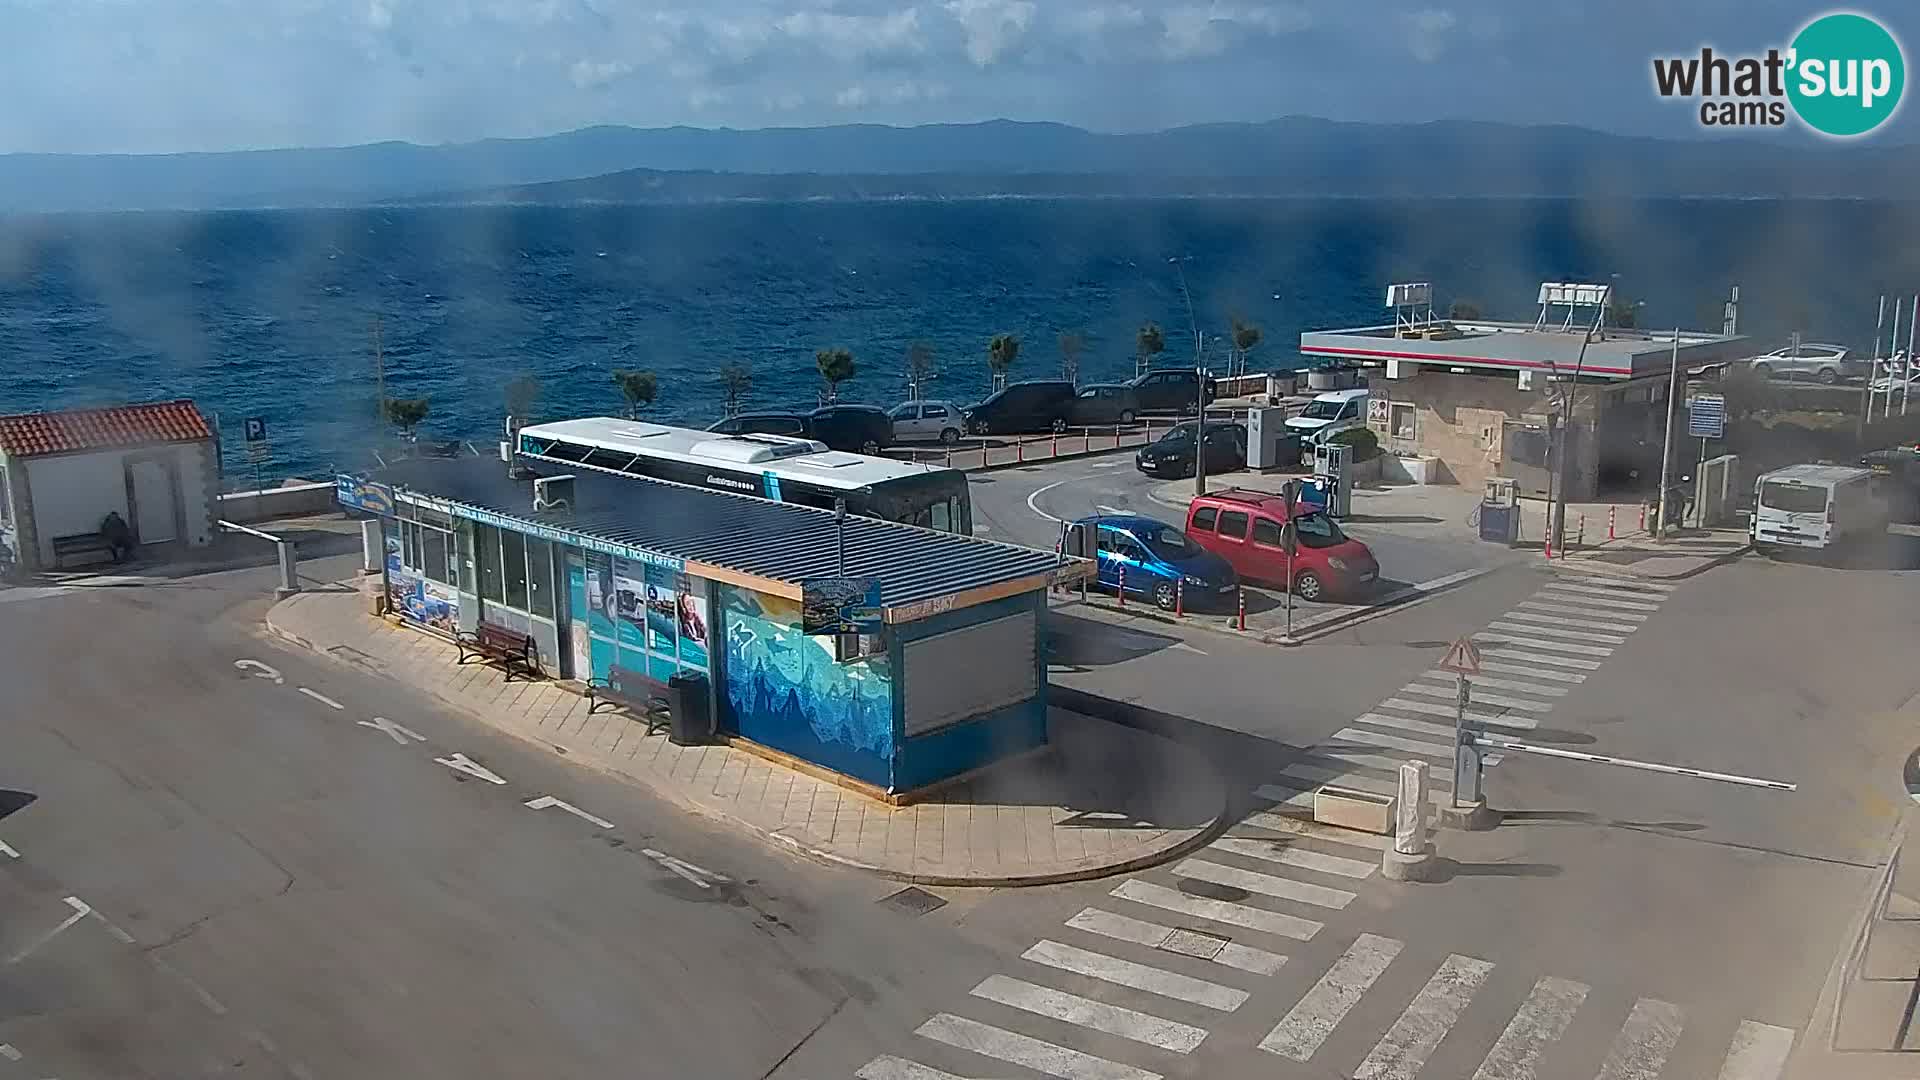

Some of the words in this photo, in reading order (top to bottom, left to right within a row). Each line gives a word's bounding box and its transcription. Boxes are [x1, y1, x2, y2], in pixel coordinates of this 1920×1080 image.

[248, 420, 261, 438] P
[579, 537, 594, 550] BUS
[595, 540, 626, 557] STATION
[627, 547, 653, 563] TICKET
[654, 553, 681, 570] OFFICE
